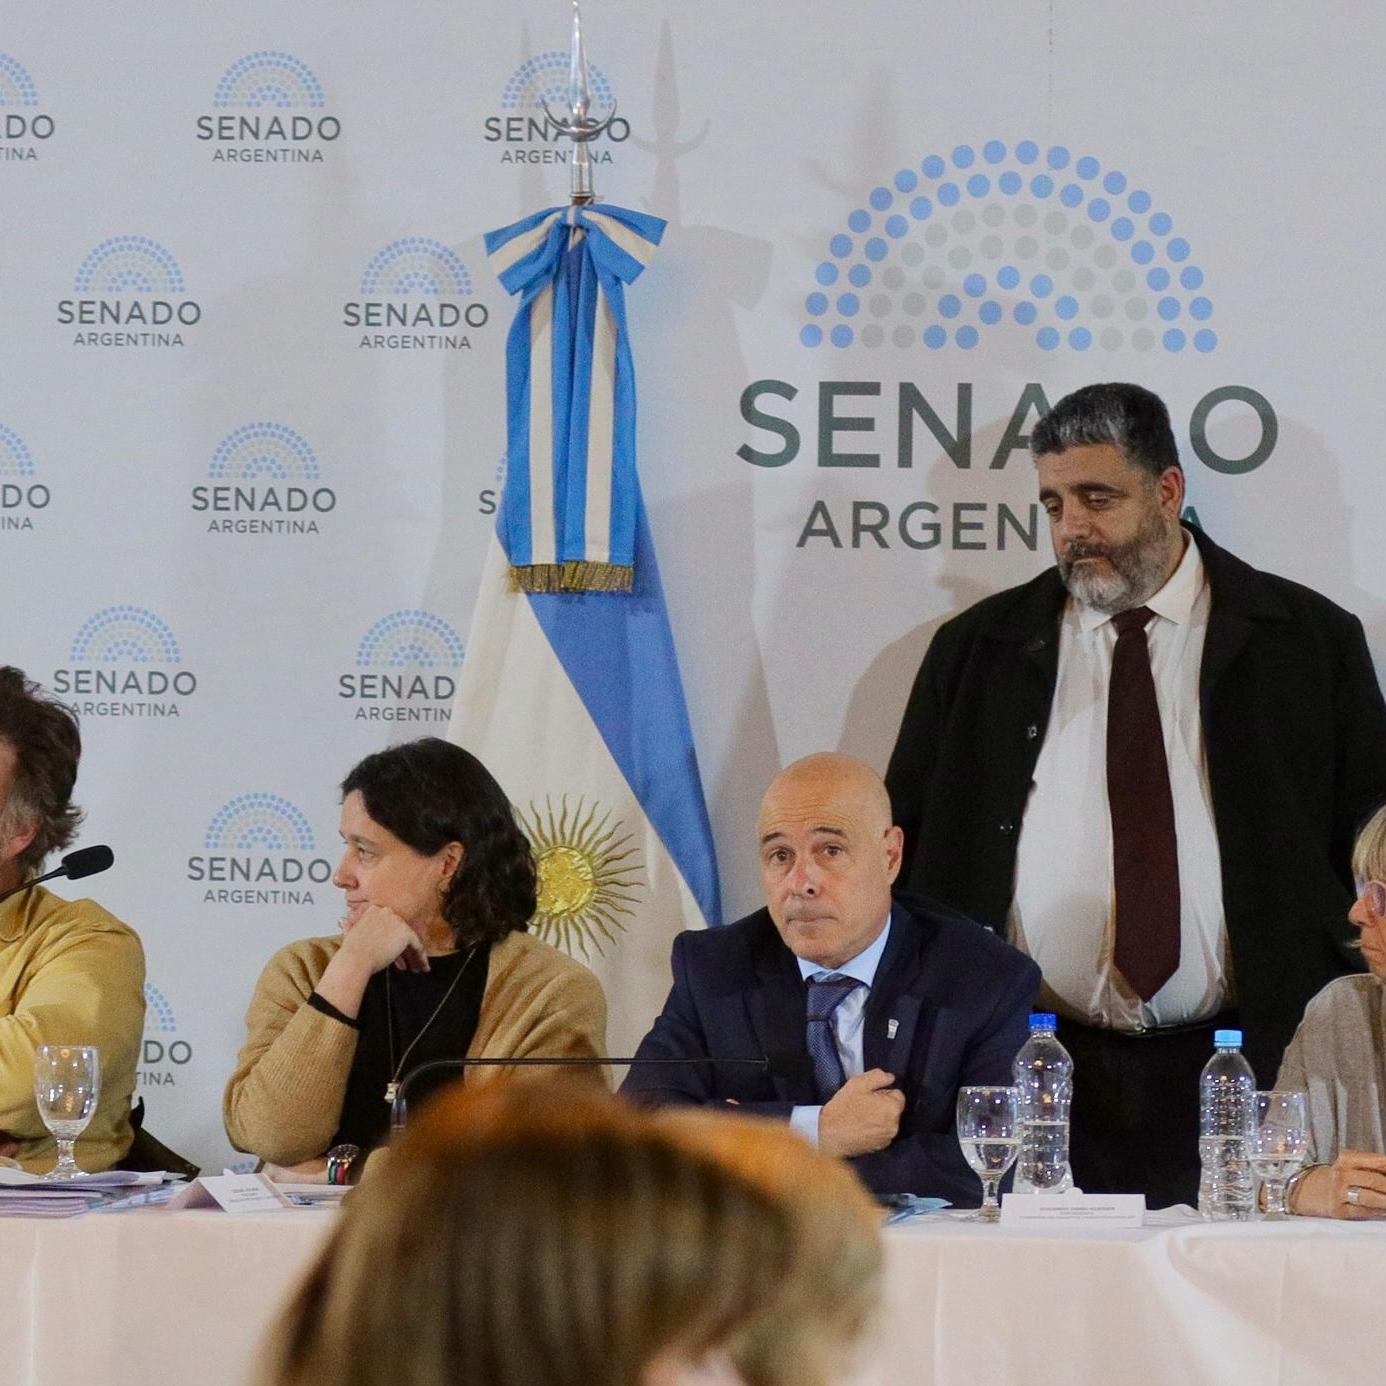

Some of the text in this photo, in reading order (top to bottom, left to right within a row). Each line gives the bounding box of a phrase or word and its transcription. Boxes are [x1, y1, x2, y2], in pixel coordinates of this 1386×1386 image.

[196, 115, 342, 142] SENADO
[211, 148, 325, 163] ARGENTINA
[500, 149, 614, 164] ARGENNA
[56, 299, 202, 326] SENADO
[342, 301, 490, 329] SENADO
[72, 331, 185, 347] ARGENTINA
[358, 334, 472, 350] ARGENTINA
[735, 378, 1280, 476] SENAO
[191, 485, 337, 513] SENADO
[207, 519, 320, 535] ARGENTINA
[795, 499, 1205, 553] ARGEN
[53, 668, 198, 697] SENADO
[338, 673, 456, 701] SENAD
[70, 701, 181, 718] ARGENTINA
[354, 706, 452, 722] ARGENTIN
[186, 855, 332, 884] SENADO
[203, 888, 315, 905] ARGENTINA
